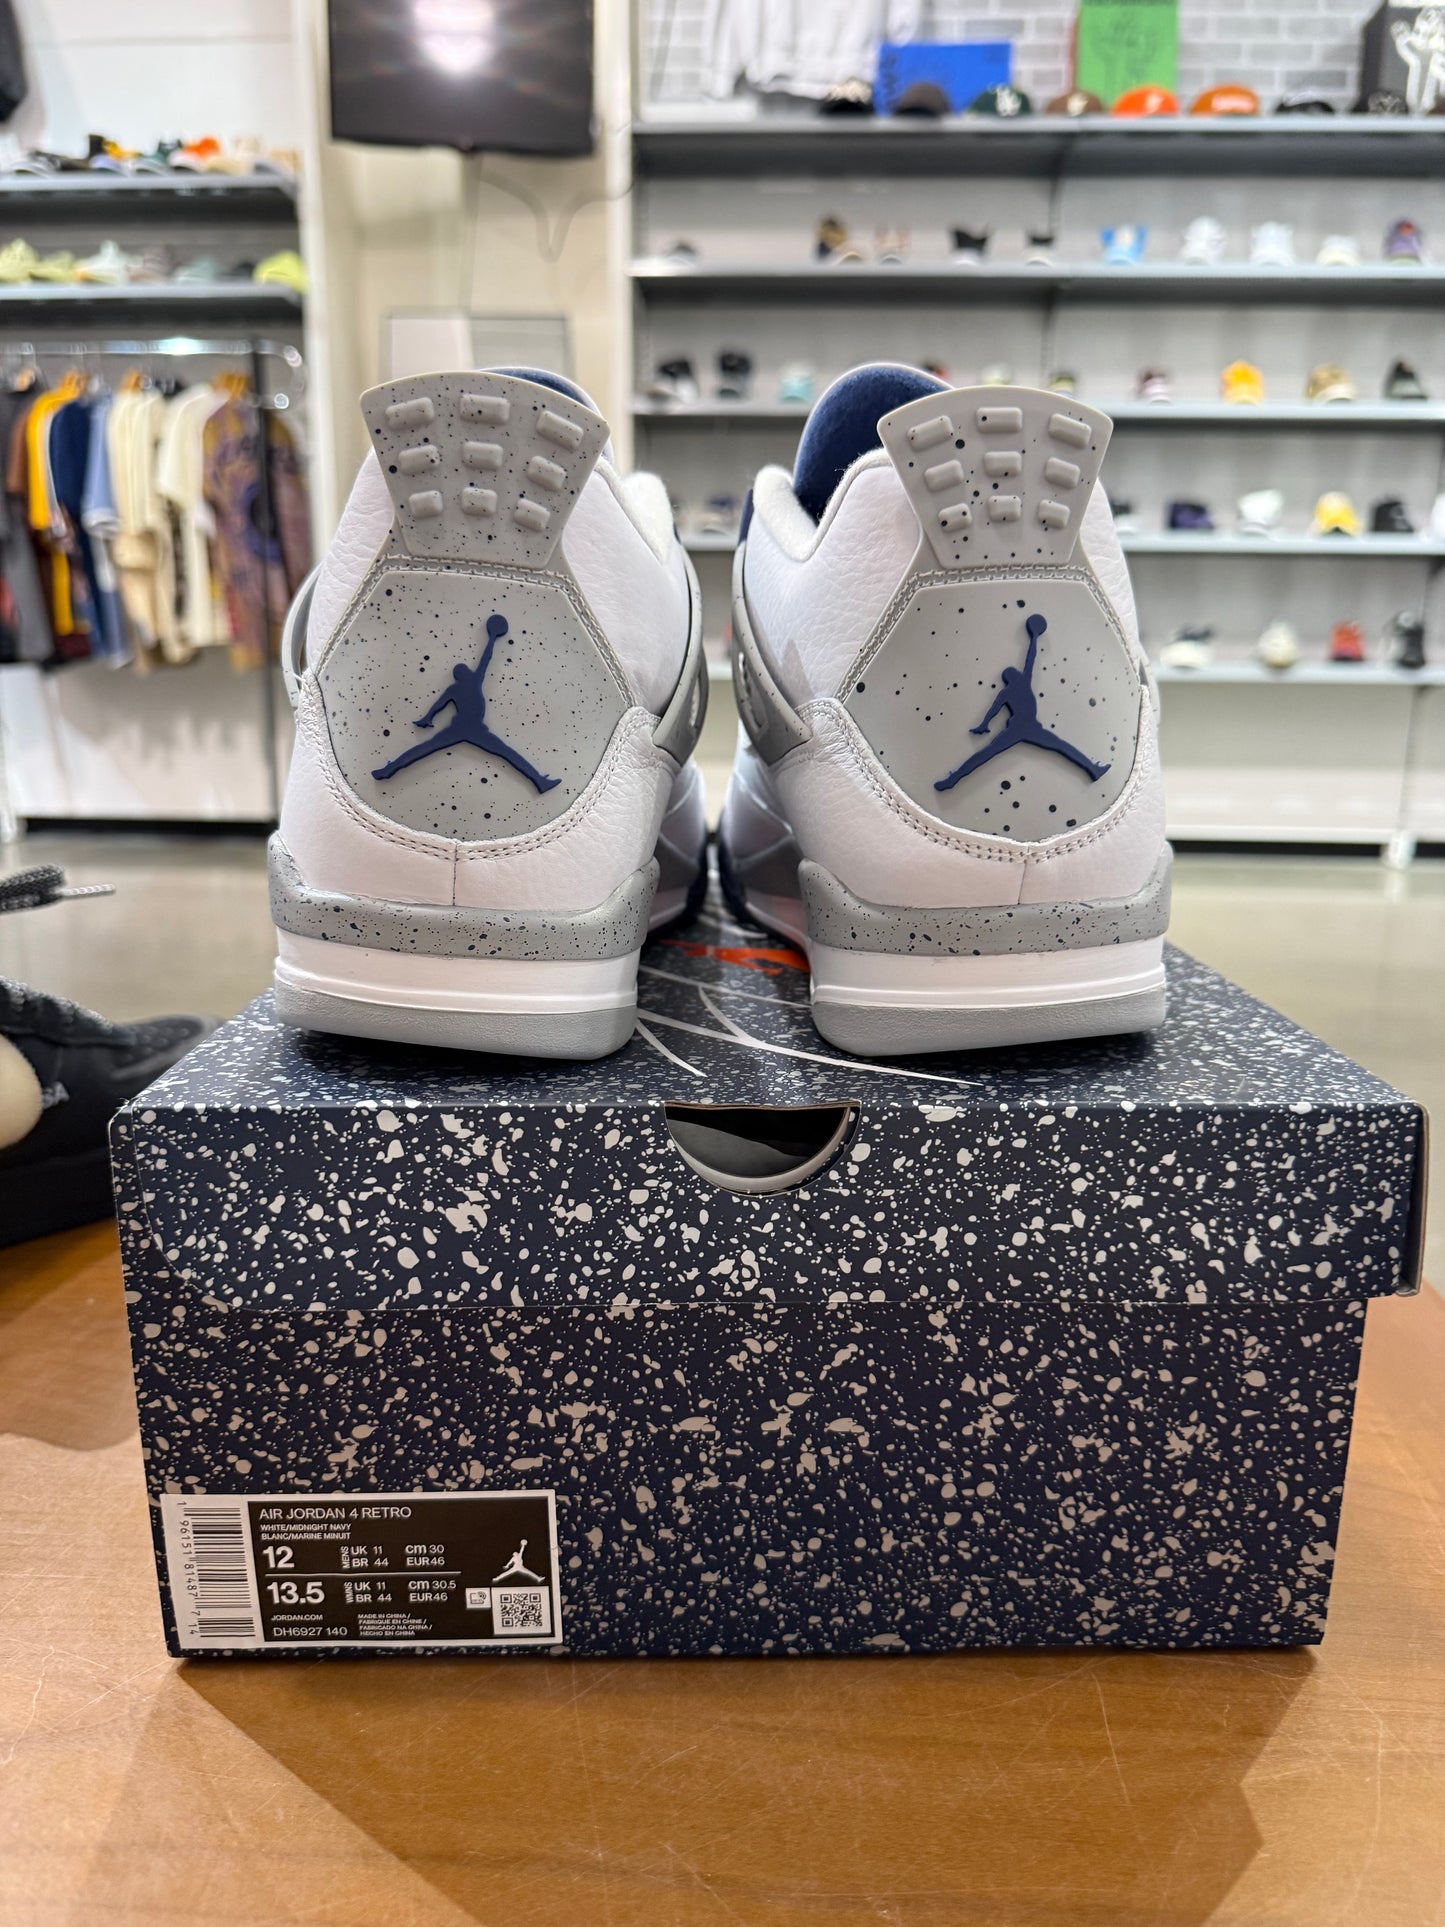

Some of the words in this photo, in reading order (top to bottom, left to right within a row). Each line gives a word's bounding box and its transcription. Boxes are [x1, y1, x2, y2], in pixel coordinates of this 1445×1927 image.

[259, 1508, 283, 1519] AIR
[286, 1507, 346, 1519] JORDAN
[349, 1507, 359, 1519] 4
[362, 1506, 412, 1518] RETRO
[260, 1523, 328, 1532] WHITE/MIDNIGHT
[330, 1523, 352, 1531] NAVY
[180, 1520, 192, 1555] 96151
[261, 1532, 323, 1541] BLANC/MARINE
[324, 1532, 351, 1540] MINUIT
[351, 1546, 368, 1555] UK
[373, 1545, 383, 1555] 11
[405, 1544, 427, 1554] cm
[429, 1544, 445, 1553] 30
[262, 1545, 295, 1569] 12
[340, 1546, 350, 1569] MENS
[352, 1558, 369, 1567] BR
[374, 1557, 389, 1567] 44
[184, 1563, 198, 1598] 81487
[408, 1580, 430, 1590] cm
[432, 1580, 456, 1589] 30.5
[354, 1582, 371, 1592] UK
[376, 1581, 386, 1591] 11
[266, 1581, 325, 1604] 13.5
[344, 1581, 354, 1604] WMNS
[355, 1594, 372, 1603] BR
[377, 1593, 392, 1602] 44
[273, 1627, 322, 1637] DH6927
[326, 1626, 348, 1636] 140
